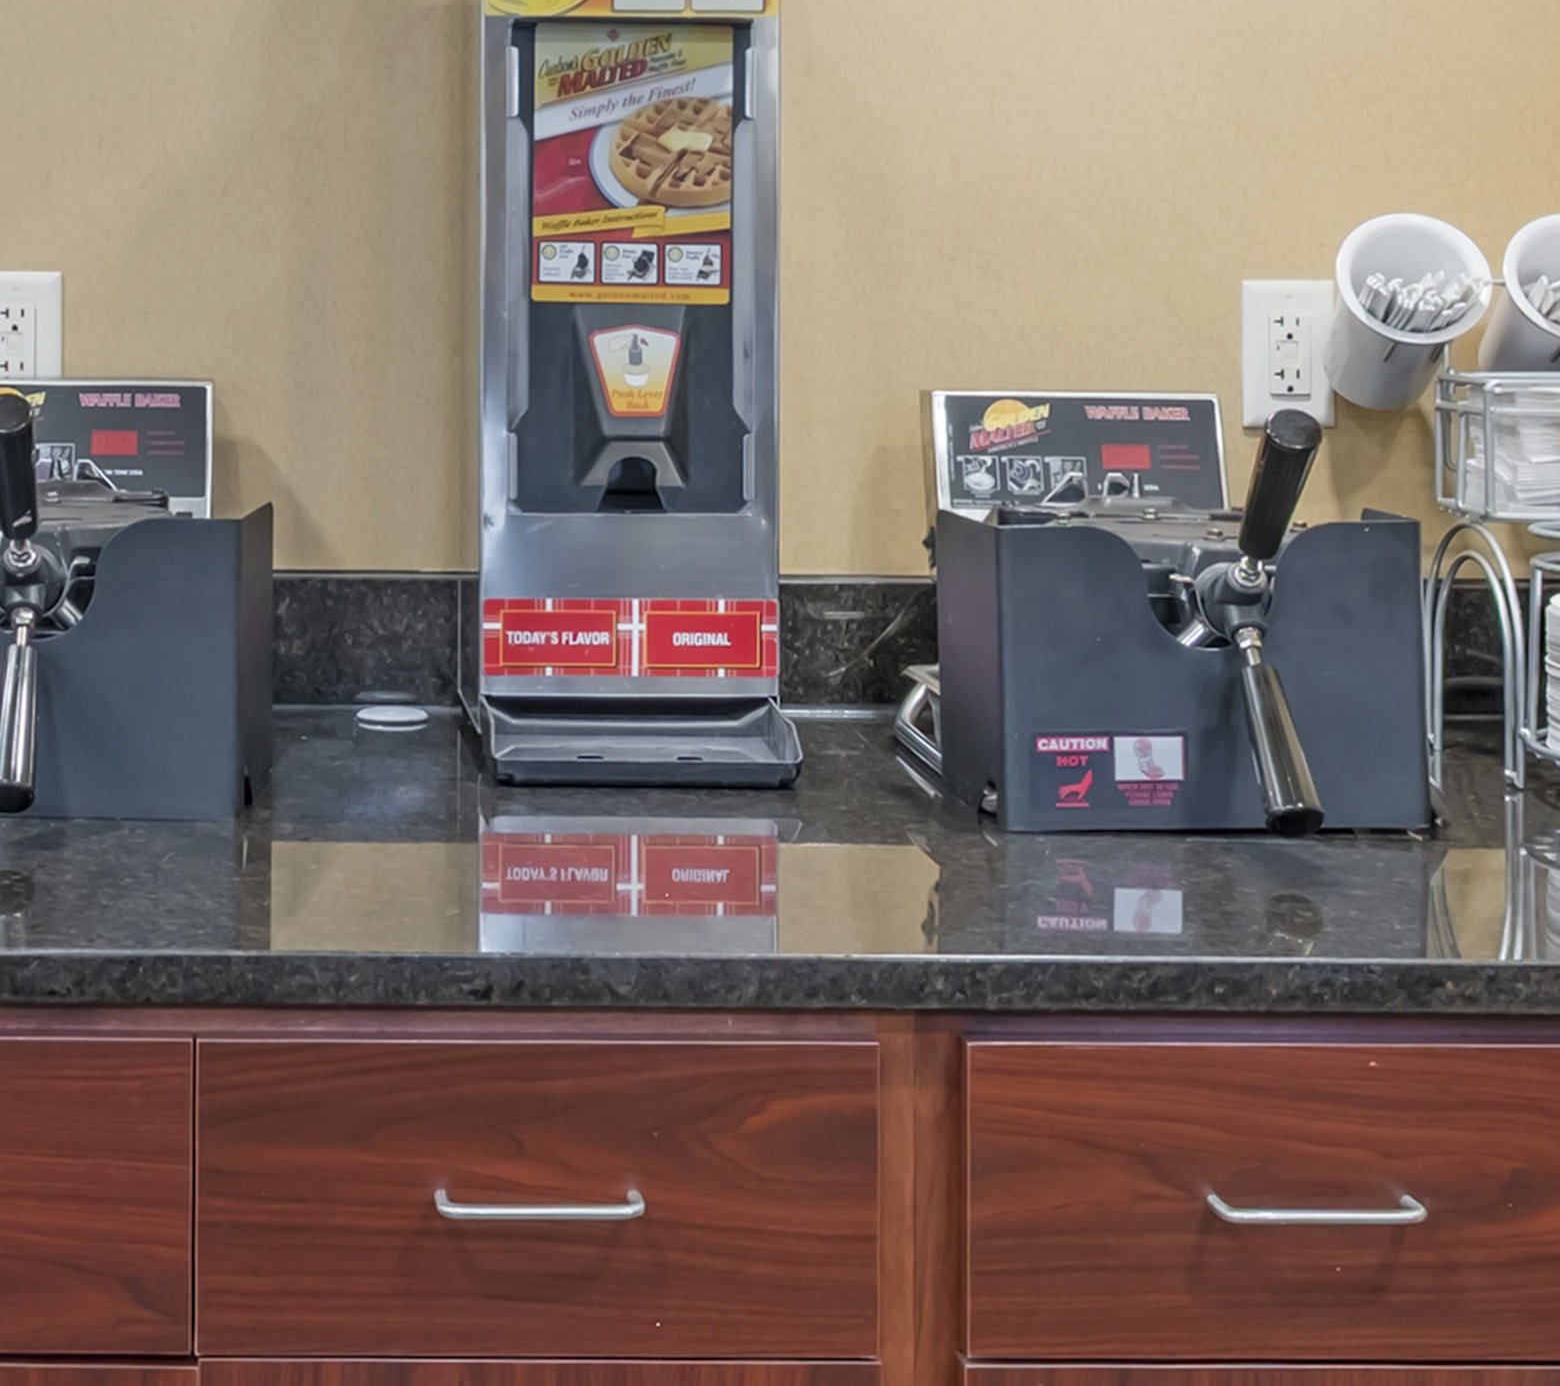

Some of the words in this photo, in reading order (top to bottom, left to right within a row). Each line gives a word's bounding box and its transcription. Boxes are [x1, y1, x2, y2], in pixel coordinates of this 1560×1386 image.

[581, 32, 672, 72] GOLDEN
[558, 58, 648, 97] MALTED
[569, 98, 619, 120] Simply
[622, 93, 644, 108] the
[647, 78, 697, 102] Finest!
[79, 393, 131, 407] WAFFLE
[134, 393, 181, 408] BAKER
[1084, 405, 1139, 420] WAFFLE
[1143, 406, 1191, 421] BAKER
[506, 631, 558, 645] TODAY'S
[562, 631, 610, 646] FLAVOR
[672, 632, 731, 646] ORIGINAL
[1037, 738, 1108, 750] CAUTION
[1056, 755, 1088, 766] HOT
